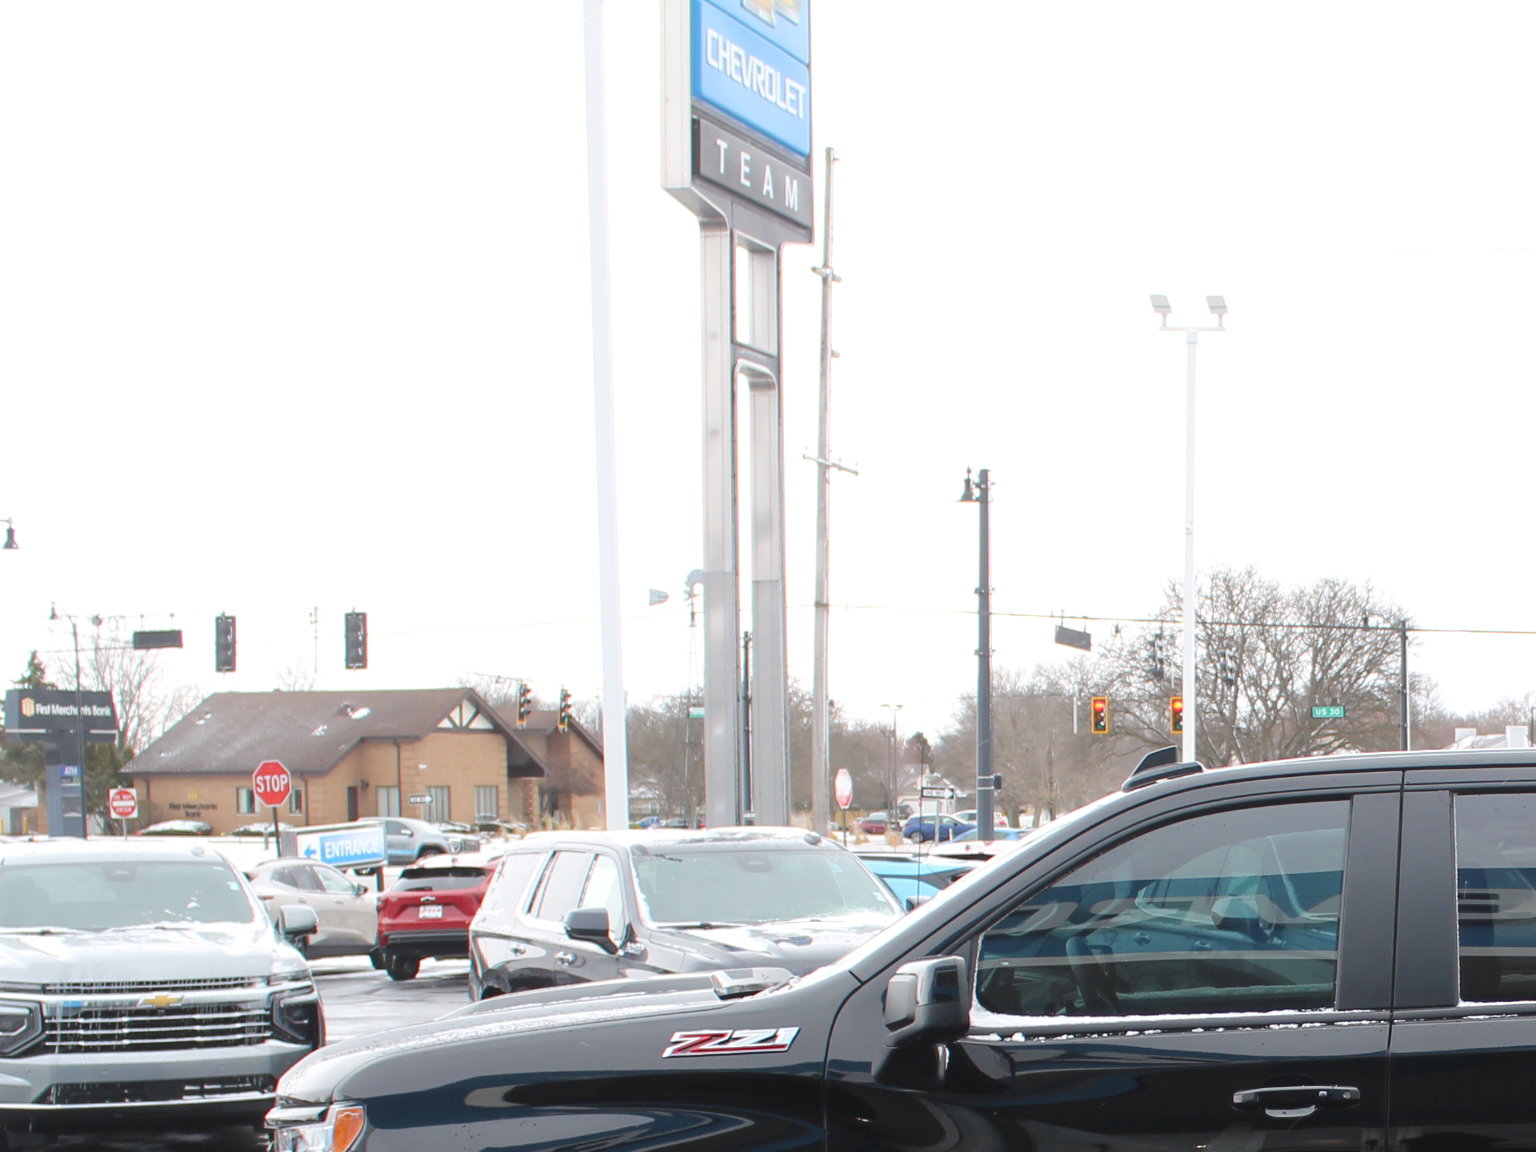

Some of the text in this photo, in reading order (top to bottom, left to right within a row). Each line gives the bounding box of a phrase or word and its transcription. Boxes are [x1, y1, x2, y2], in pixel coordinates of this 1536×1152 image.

[706, 27, 806, 119] CHEVROLET
[716, 138, 799, 212] TEAM
[35, 703, 51, 716] First
[92, 705, 112, 717] Bank
[256, 775, 288, 793] STOP
[325, 838, 379, 859] ENTRANCE
[662, 1026, 801, 1058] Z71
